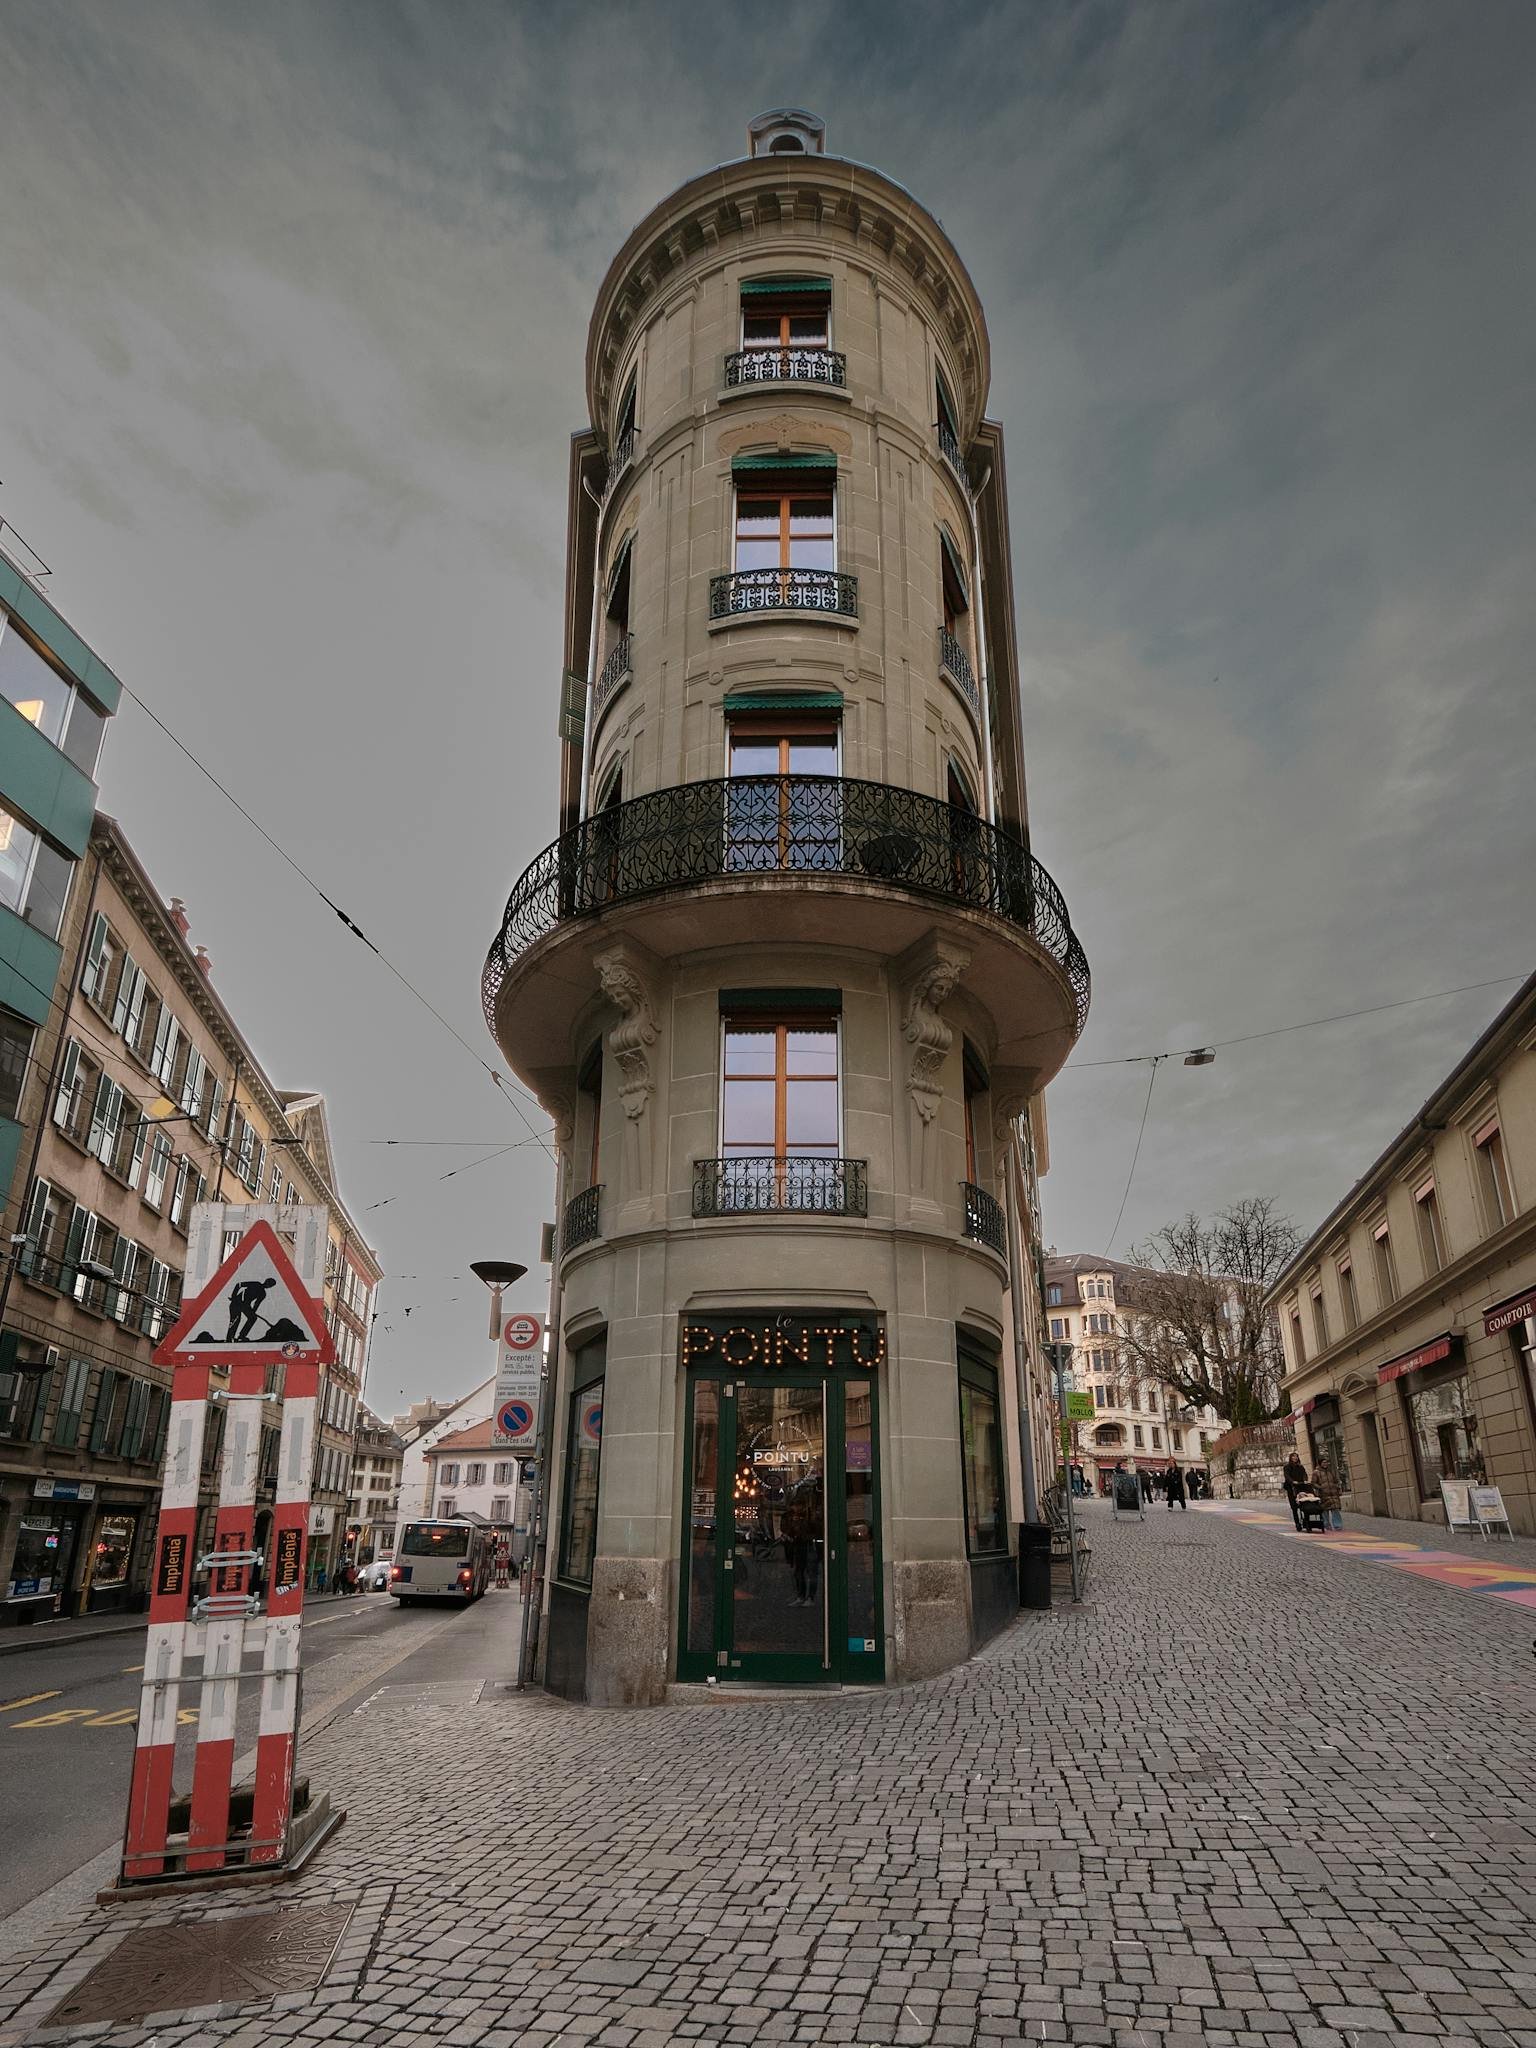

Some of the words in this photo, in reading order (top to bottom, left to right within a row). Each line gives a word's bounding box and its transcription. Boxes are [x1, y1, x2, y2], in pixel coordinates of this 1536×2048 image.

[776, 1311, 794, 1328] le
[1488, 1302, 1533, 1332] COMPTOIR
[682, 1326, 885, 1367] POINTU
[753, 1451, 809, 1463] POINTU
[163, 1538, 182, 1592] Implenia
[281, 1531, 298, 1585] Implenia
